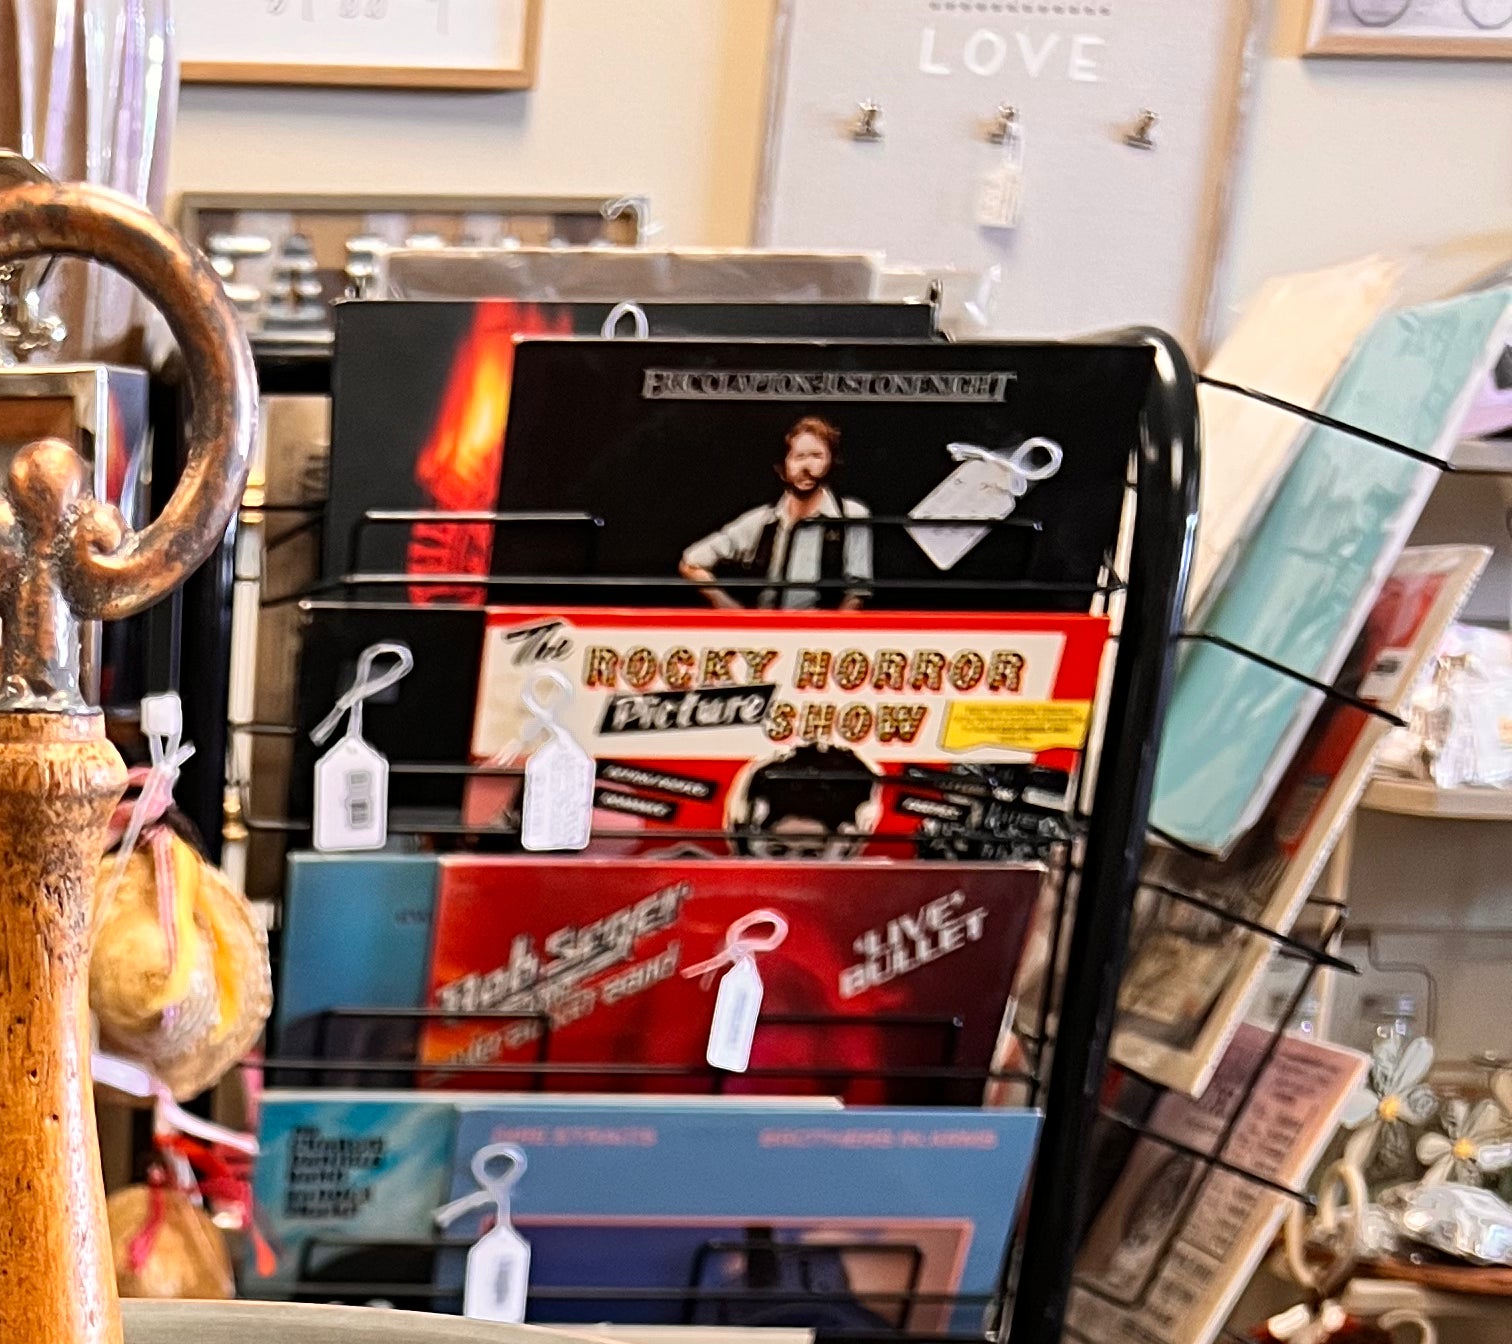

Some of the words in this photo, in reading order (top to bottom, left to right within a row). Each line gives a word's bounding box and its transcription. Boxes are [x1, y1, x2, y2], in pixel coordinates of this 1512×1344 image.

[917, 27, 1109, 83] LOVE
[505, 621, 573, 666] The
[584, 646, 779, 690] ROCKY
[793, 648, 1025, 692] HORROR
[608, 691, 766, 732] Picture
[765, 703, 928, 743] SHOW
[838, 906, 989, 1000] BULLET
